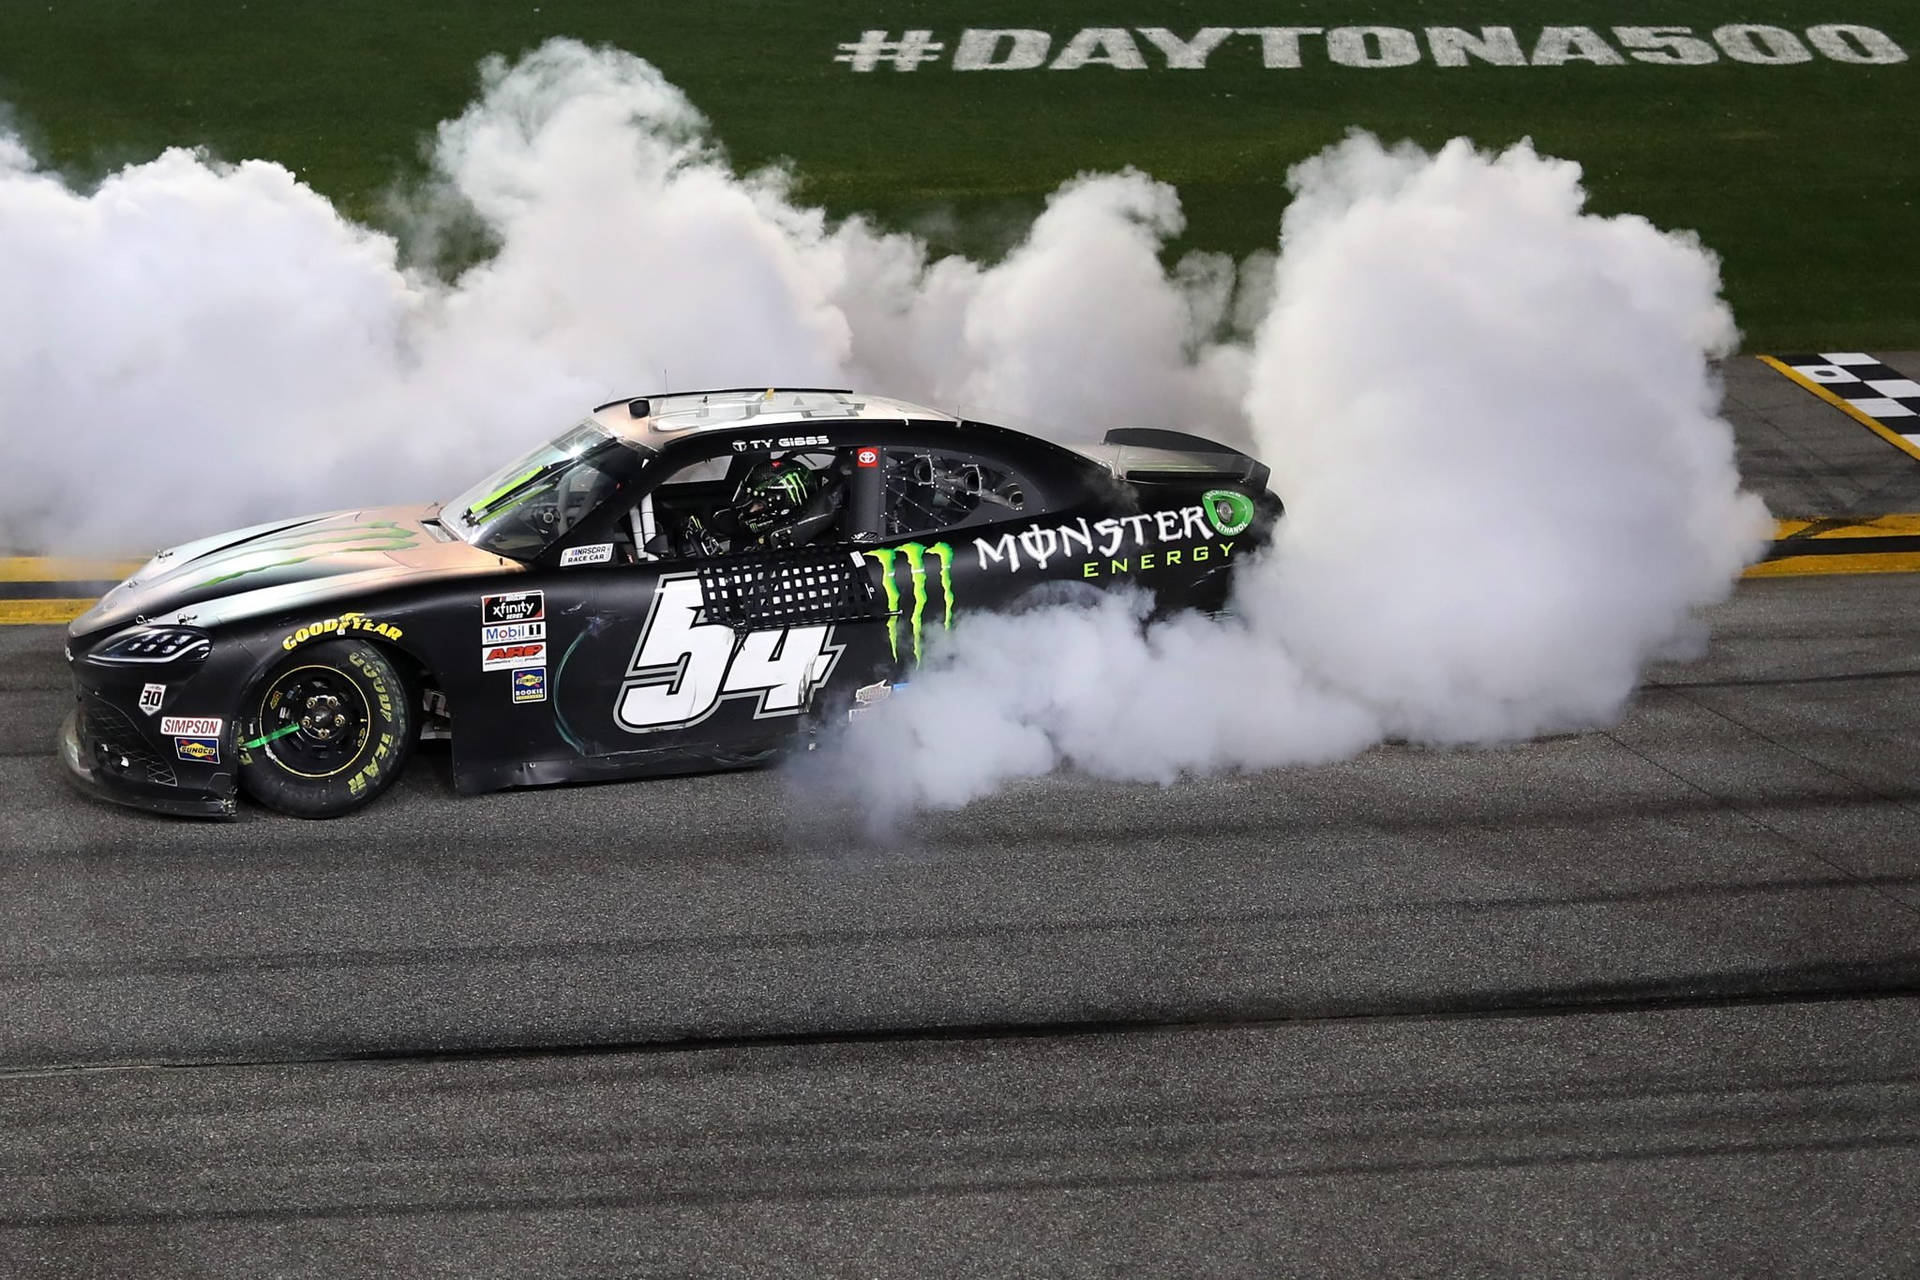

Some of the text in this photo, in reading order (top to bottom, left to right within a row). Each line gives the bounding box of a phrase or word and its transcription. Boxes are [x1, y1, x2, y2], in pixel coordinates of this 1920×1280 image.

[834, 24, 1909, 72] #DAYTONA500
[750, 439, 773, 449] TY
[779, 435, 830, 447] GIBBS
[972, 505, 1214, 573] MONSTER
[567, 553, 605, 563] RACE CAR
[1083, 542, 1235, 578] ENERGY
[492, 601, 535, 618] xfinity
[282, 613, 403, 650] GOODYEAR
[486, 625, 525, 640] Mobil
[529, 623, 541, 636] 1
[486, 644, 544, 661] ARP
[612, 571, 848, 734] 54
[140, 690, 162, 707] 30
[515, 688, 544, 696] ROOKIE
[163, 719, 218, 735] SIMPSON
[181, 746, 215, 756] SUNOCO
